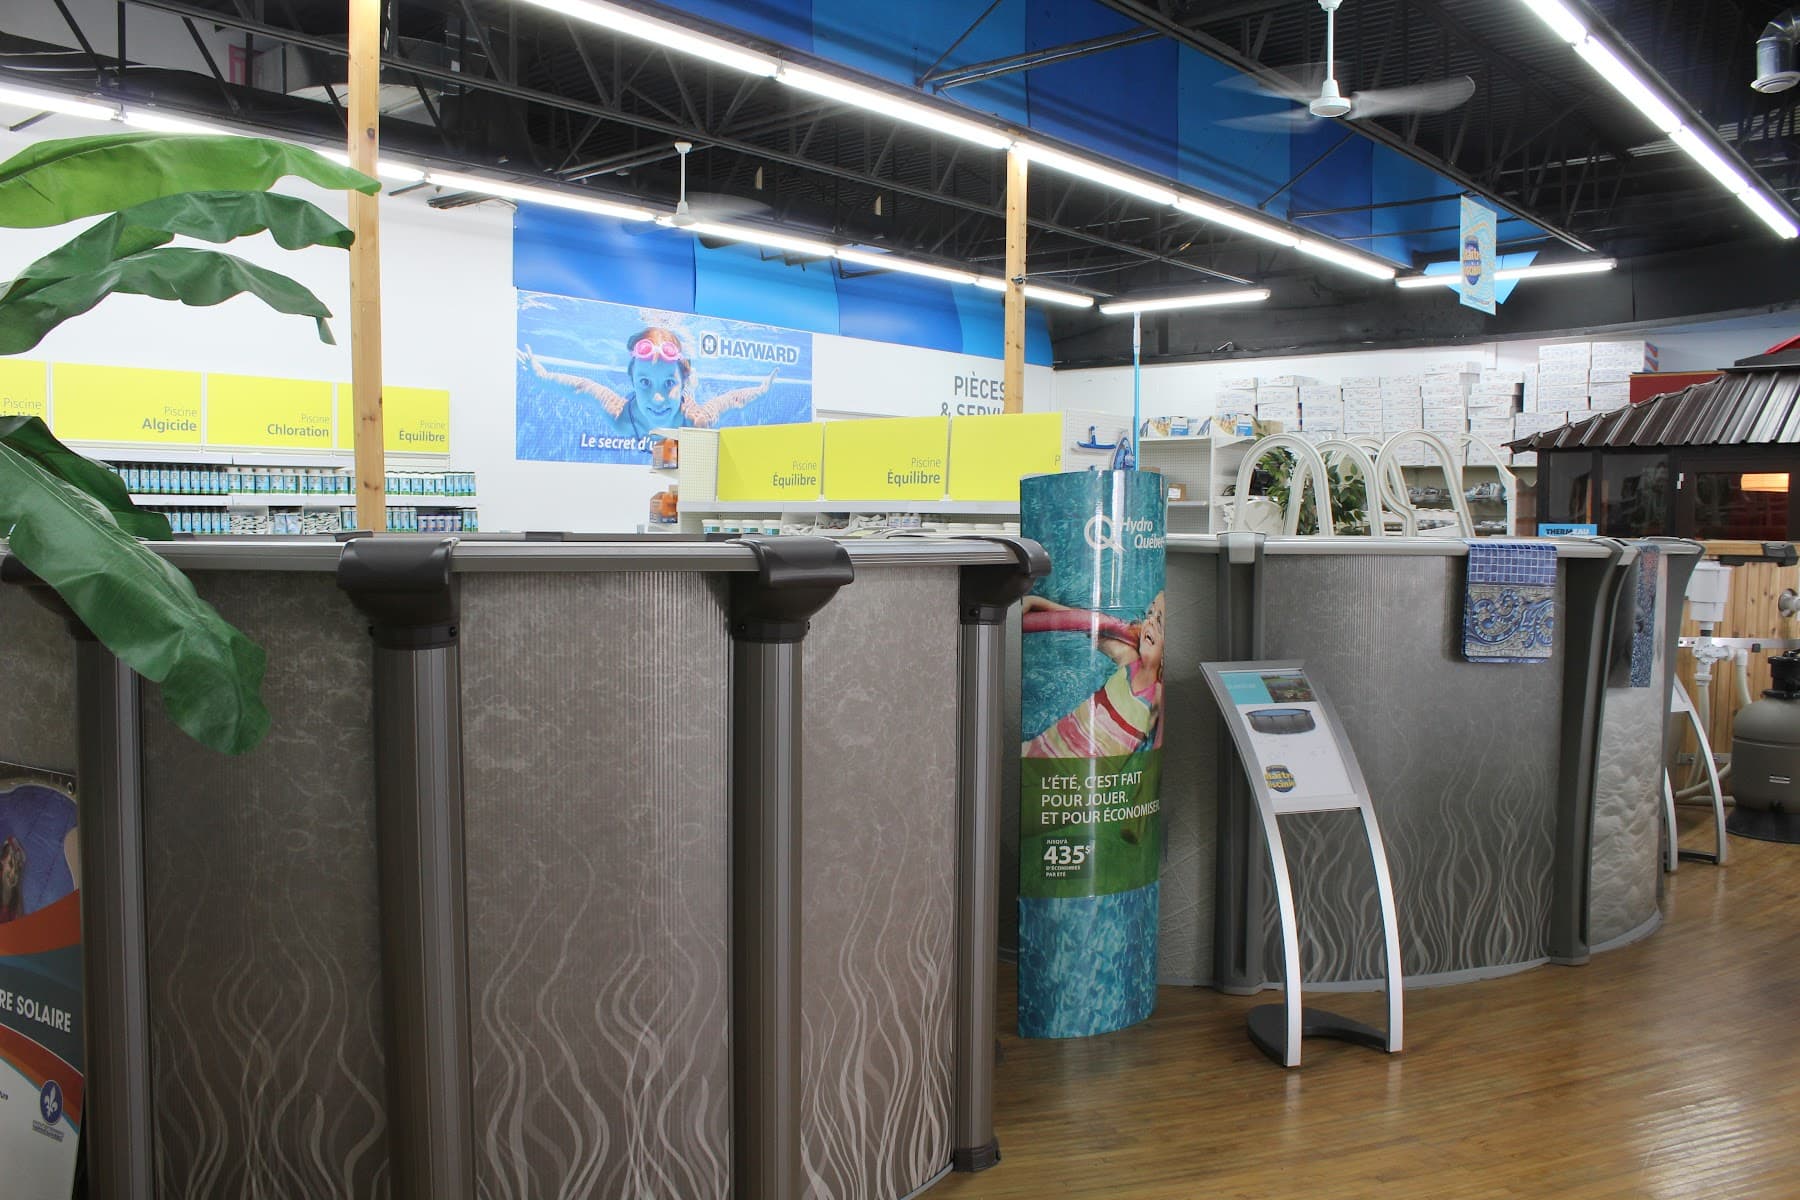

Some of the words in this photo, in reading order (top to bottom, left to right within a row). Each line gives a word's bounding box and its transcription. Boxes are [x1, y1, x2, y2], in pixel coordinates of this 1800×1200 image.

[720, 339, 798, 363] HAYWARD
[3, 397, 42, 409] Piscine
[164, 405, 198, 417] Piscine
[142, 418, 197, 433] Algicide
[301, 414, 330, 424] Piscine
[420, 420, 446, 430] Piscine
[267, 423, 329, 437] Chloration
[399, 430, 446, 443] Équilibre
[581, 433, 597, 447] Le
[598, 436, 636, 450] secret
[792, 460, 817, 471] Piscine
[911, 457, 941, 468] Piscine
[773, 473, 817, 489] Équilibre
[887, 469, 941, 487] Équilibre
[1121, 516, 1153, 535] Hydro
[1041, 775, 1081, 791] L'ÉTÉ,
[1084, 774, 1119, 789] C'EST
[1121, 771, 1143, 786] FAIT
[1041, 794, 1082, 807] POUR
[1085, 790, 1129, 807] JOUER.
[1041, 812, 1059, 825] ET
[1062, 810, 1100, 825] POUR
[16, 995, 71, 1033] SOLAIRE
